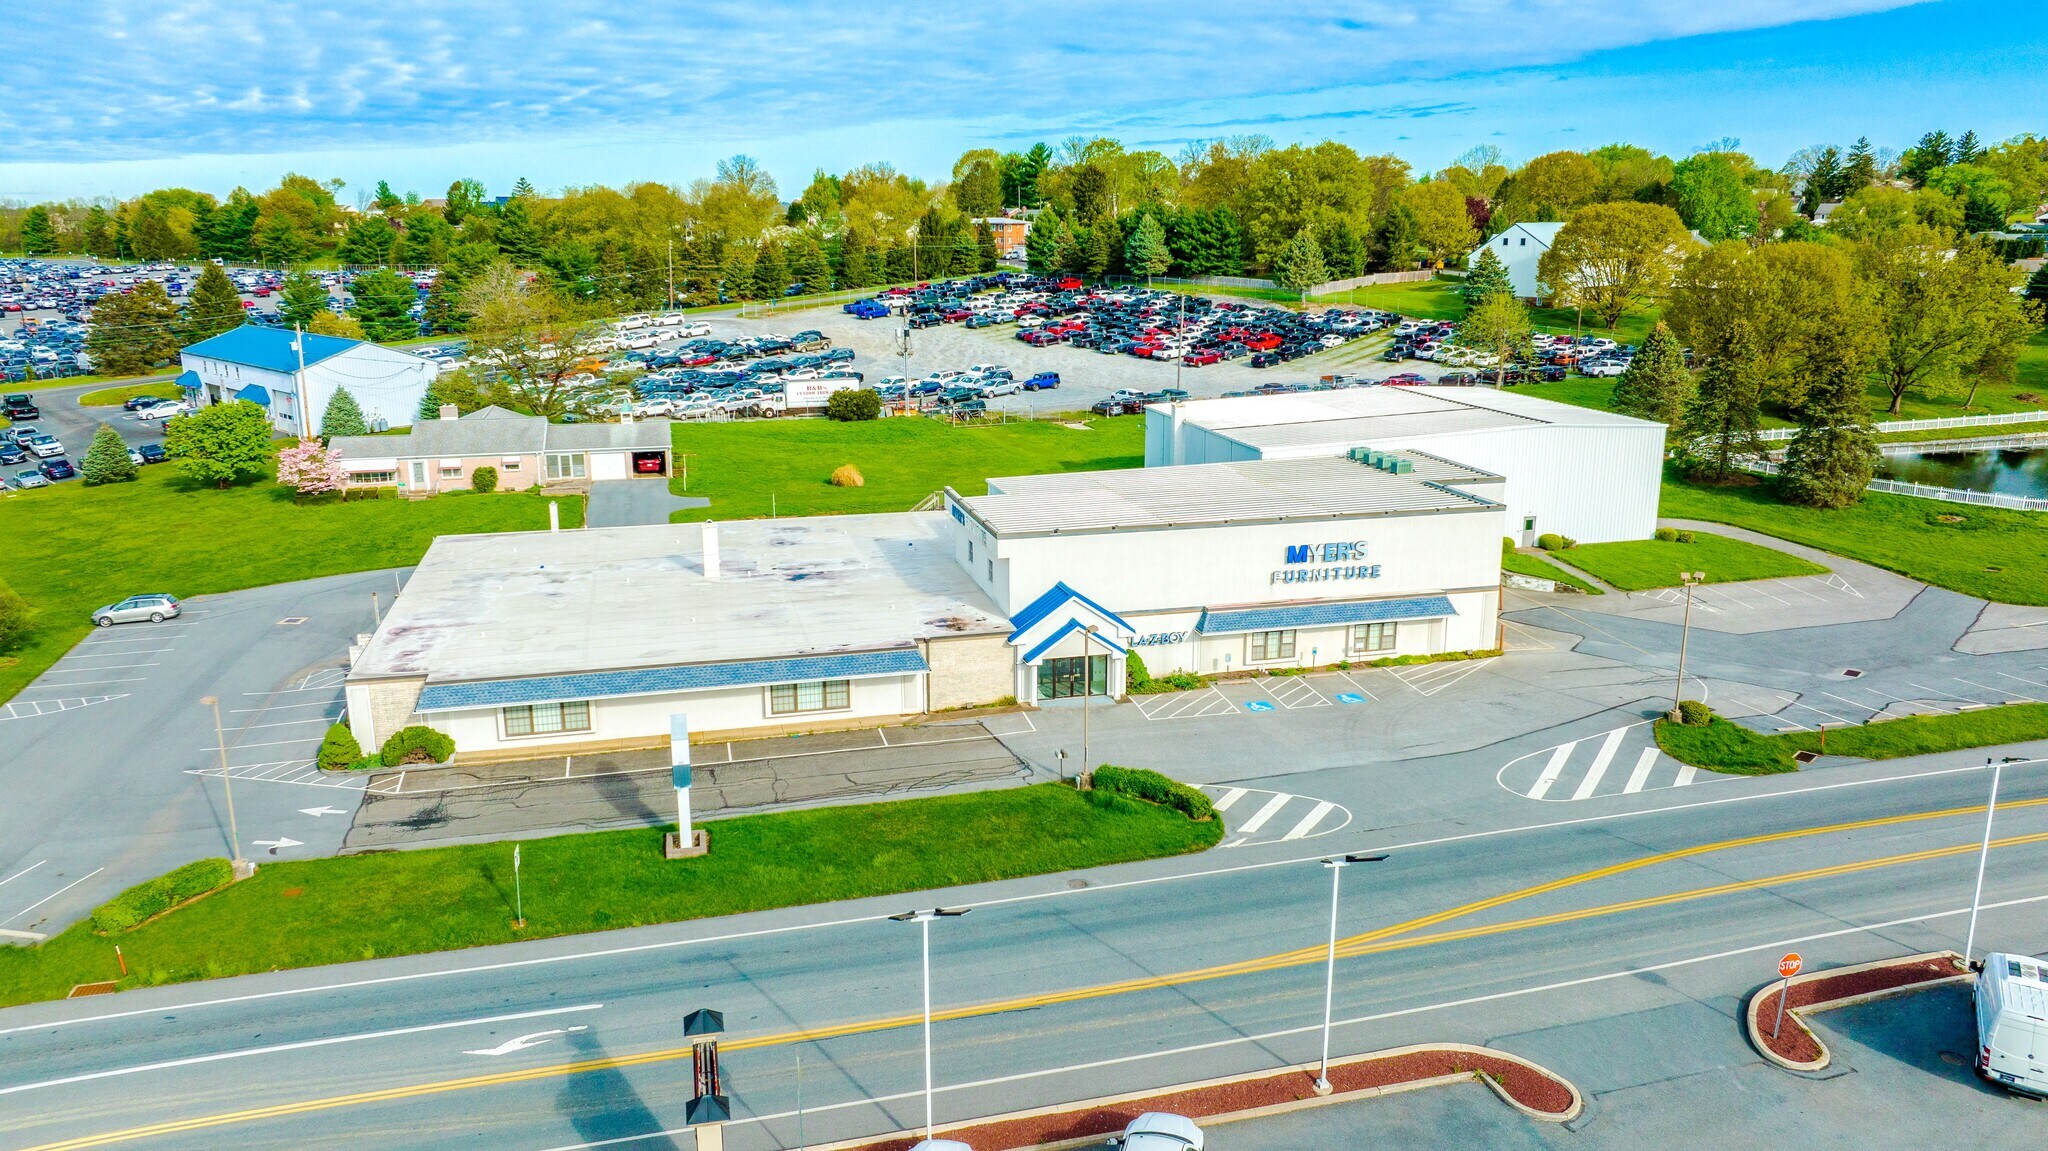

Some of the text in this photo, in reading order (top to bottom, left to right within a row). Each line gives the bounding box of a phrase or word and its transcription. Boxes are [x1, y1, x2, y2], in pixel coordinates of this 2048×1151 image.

[1285, 541, 1368, 563] MYER'S
[1270, 565, 1381, 584] FURNITURE
[1780, 960, 1801, 970] STOP
